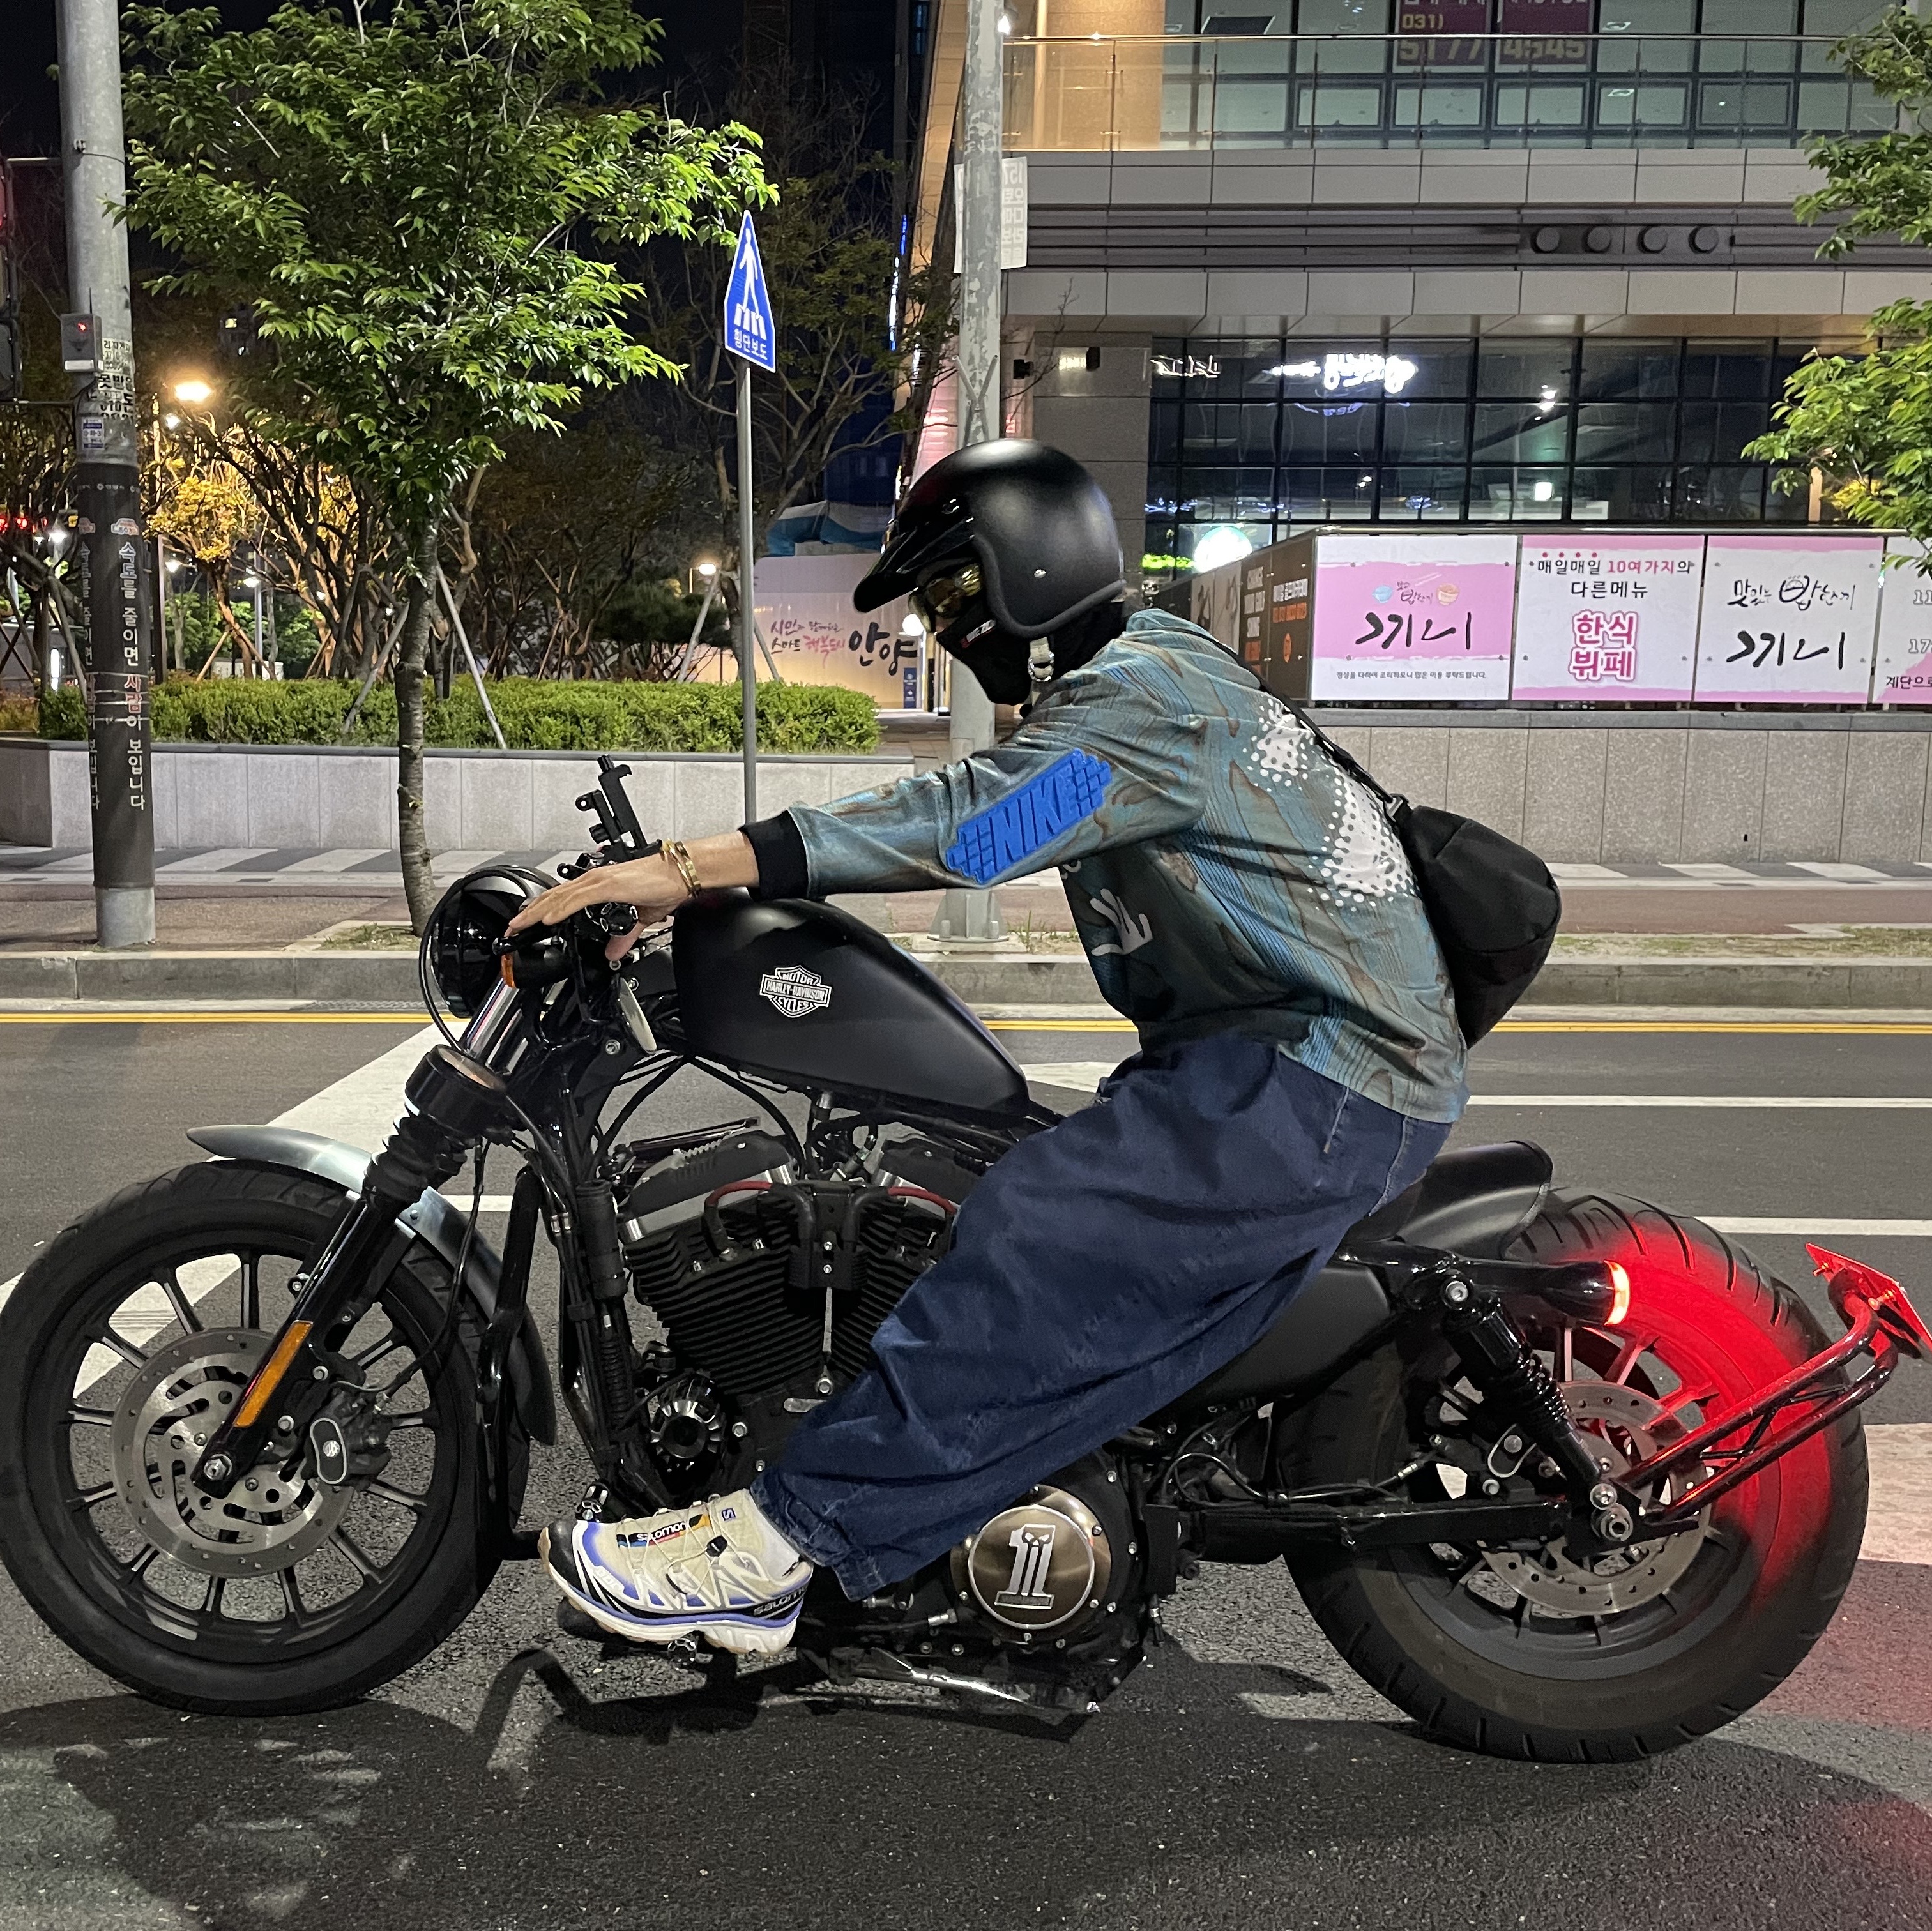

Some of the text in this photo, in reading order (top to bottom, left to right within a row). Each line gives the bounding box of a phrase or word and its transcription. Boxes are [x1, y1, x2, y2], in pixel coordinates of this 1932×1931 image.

[734, 328, 768, 360] 횡단보도
[119, 541, 137, 600] 속도를
[1537, 559, 1691, 575] 매일매일 10여가지의
[1727, 578, 1772, 607] 맛있는
[122, 607, 138, 667] 줄이면
[1574, 610, 1638, 647] 한식
[770, 637, 801, 655] 스마트
[848, 621, 918, 676] 안양
[1908, 639, 1932, 654] 17
[1569, 648, 1636, 681] 뷔페
[124, 674, 142, 731] 사람이
[128, 739, 145, 811] 보입니다
[766, 980, 826, 1001] HARLEY-DAVIDSON
[782, 971, 814, 985] MOTOR
[777, 996, 809, 1013] CYCLES
